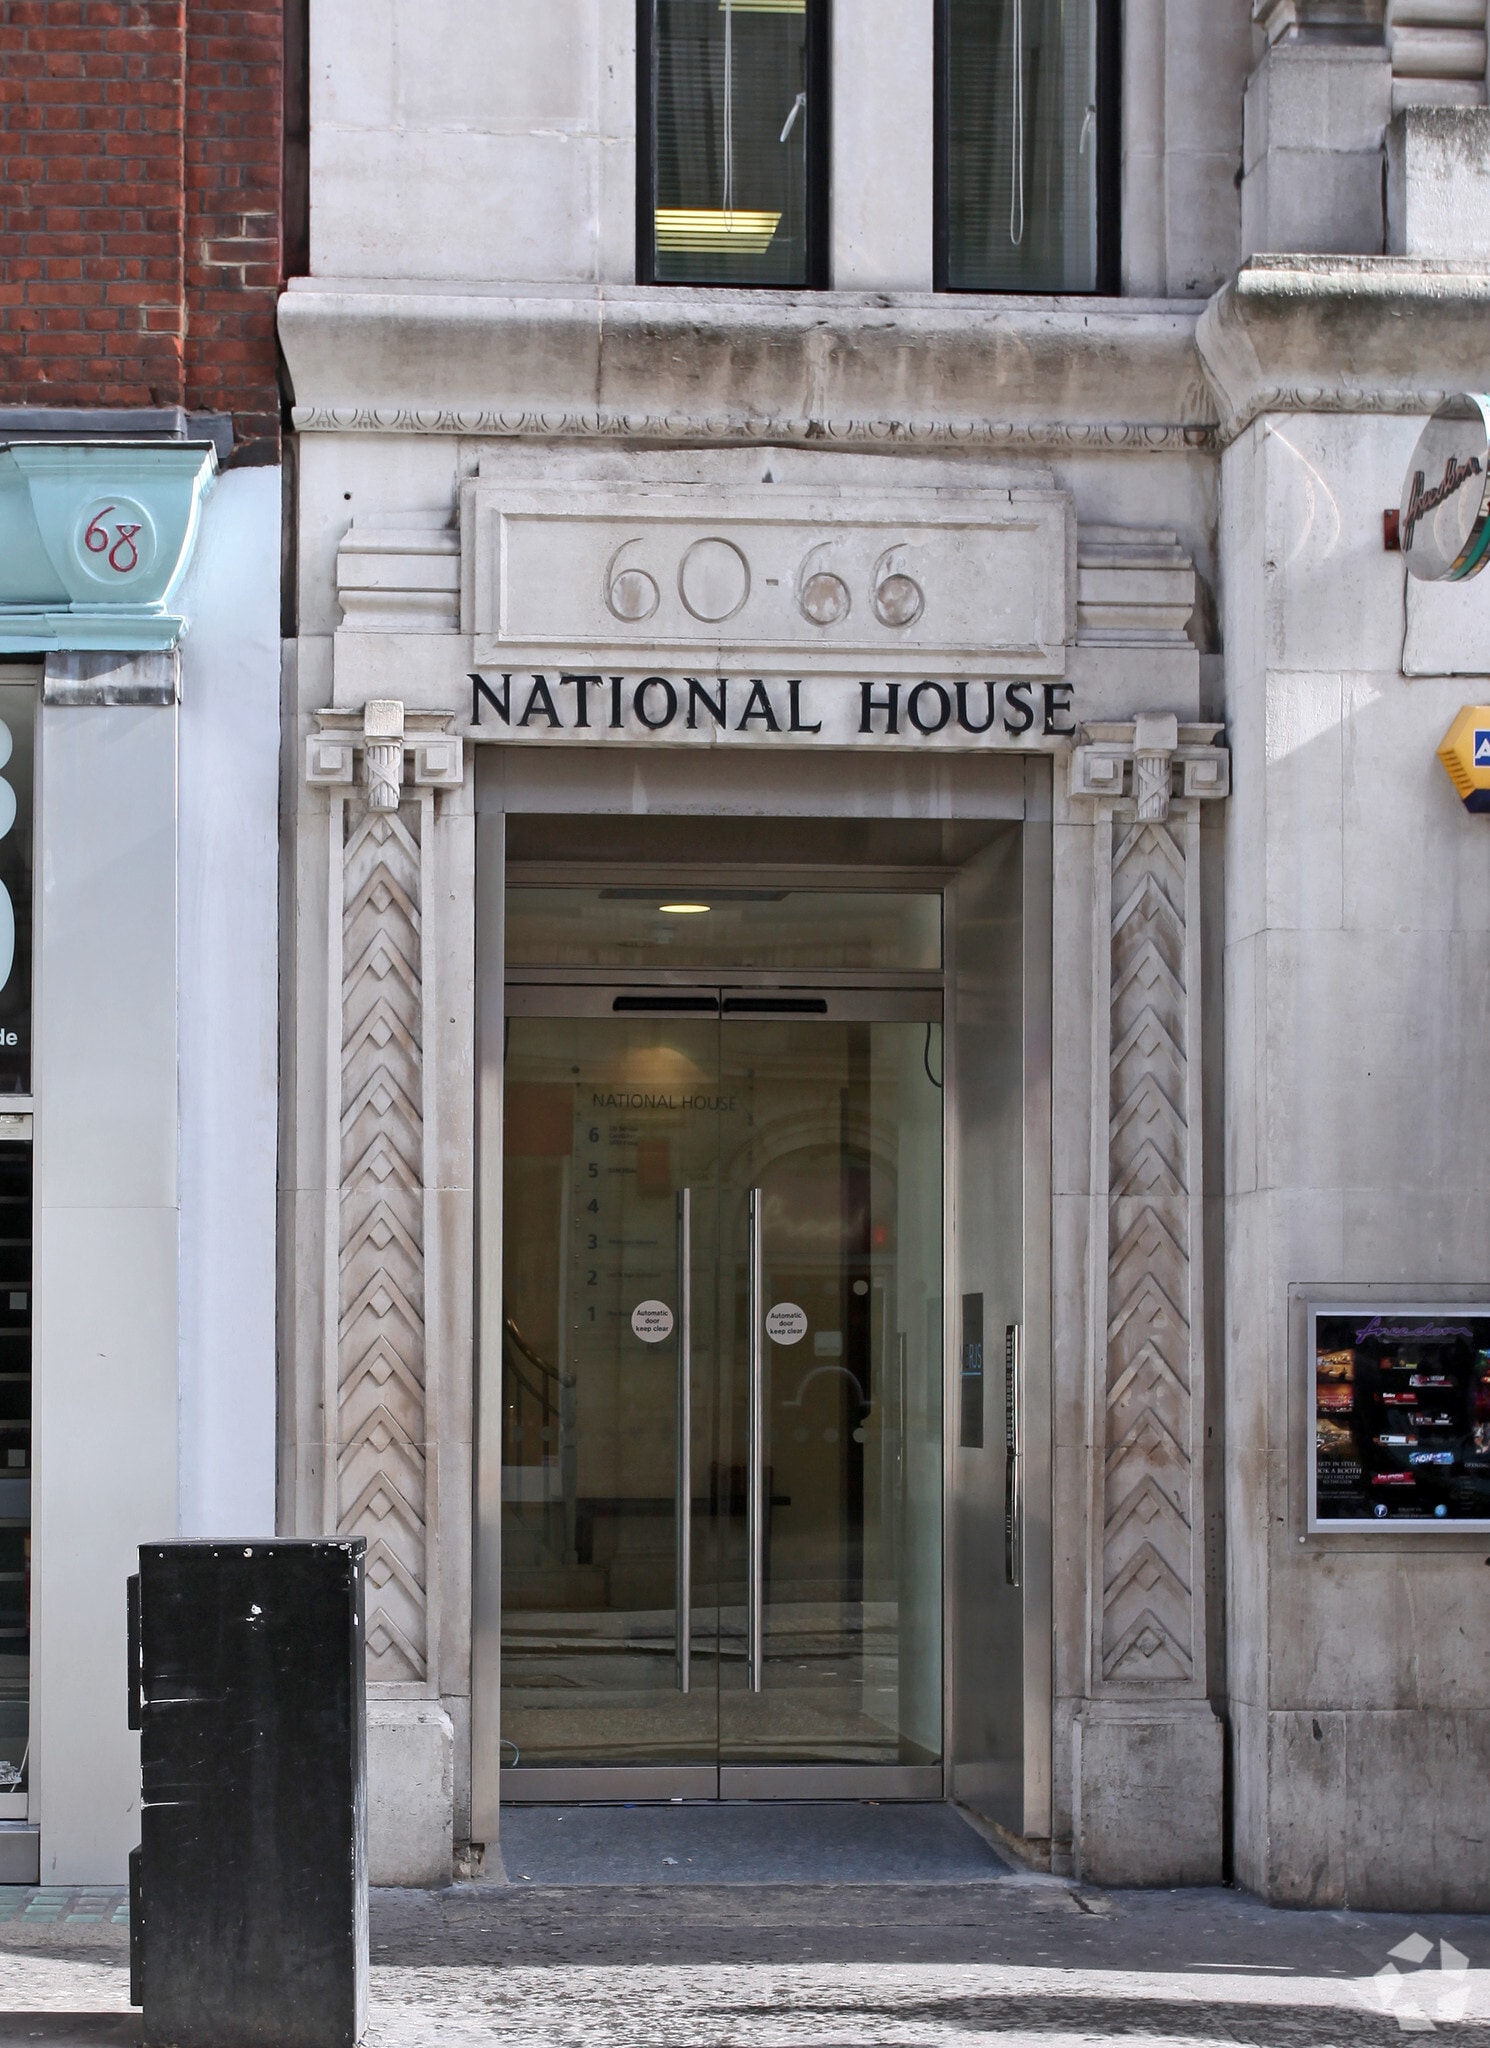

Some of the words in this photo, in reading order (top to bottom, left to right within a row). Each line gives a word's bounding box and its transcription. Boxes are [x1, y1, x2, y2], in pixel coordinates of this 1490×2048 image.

[85, 505, 142, 573] 68
[603, 536, 925, 629] 60-66
[467, 673, 823, 732] NATIONAL
[858, 679, 1077, 736] HOUSE
[592, 1093, 677, 1110] NATIONAL
[681, 1094, 737, 1112] HOUSE
[588, 1127, 600, 1143] 6
[588, 1163, 599, 1178] 5
[587, 1198, 599, 1214] 4
[587, 1233, 598, 1250] 3
[586, 1270, 598, 1286] 2
[586, 1306, 596, 1321] 1
[636, 1309, 668, 1318] Automatic
[644, 1317, 660, 1325] door
[770, 1312, 802, 1320] Automatic
[635, 1325, 652, 1333] keep
[778, 1319, 794, 1327] door
[769, 1328, 786, 1336] keep
[787, 1327, 803, 1335] clear
